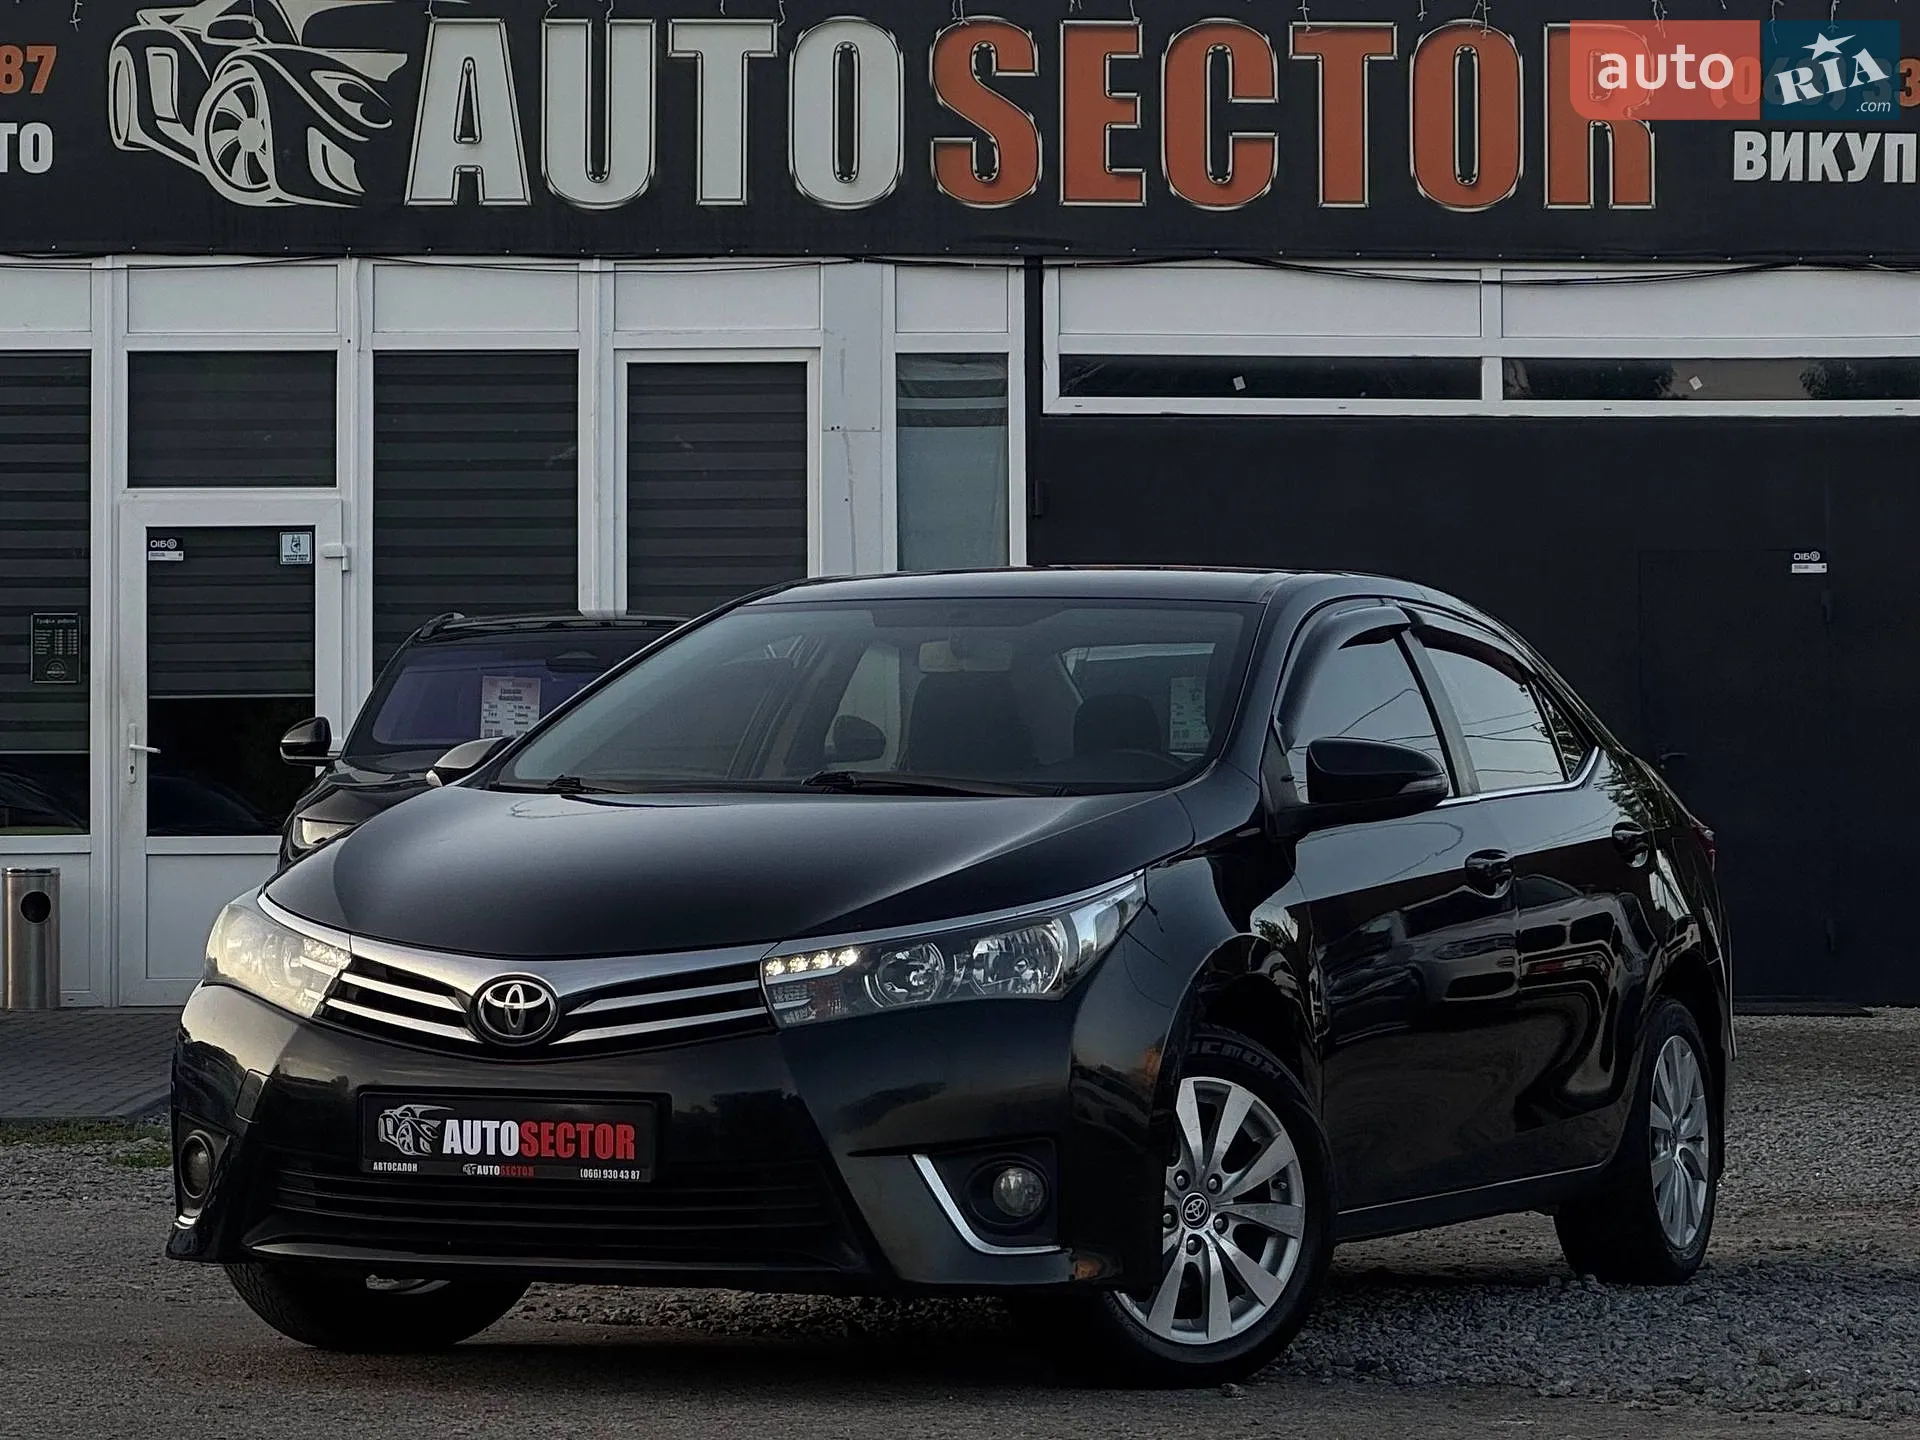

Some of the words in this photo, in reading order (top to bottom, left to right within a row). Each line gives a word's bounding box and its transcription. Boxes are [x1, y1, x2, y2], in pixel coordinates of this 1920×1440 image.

[404, 16, 1656, 212] AUTOSECTOR
[1733, 131, 1917, 183] ВИКУП
[442, 1119, 636, 1160] AUTOSECTOR
[373, 1162, 418, 1172] АВТОСАЛОН
[602, 1169, 618, 1179] 930
[620, 1170, 630, 1179] 43
[631, 1170, 640, 1180] 87
